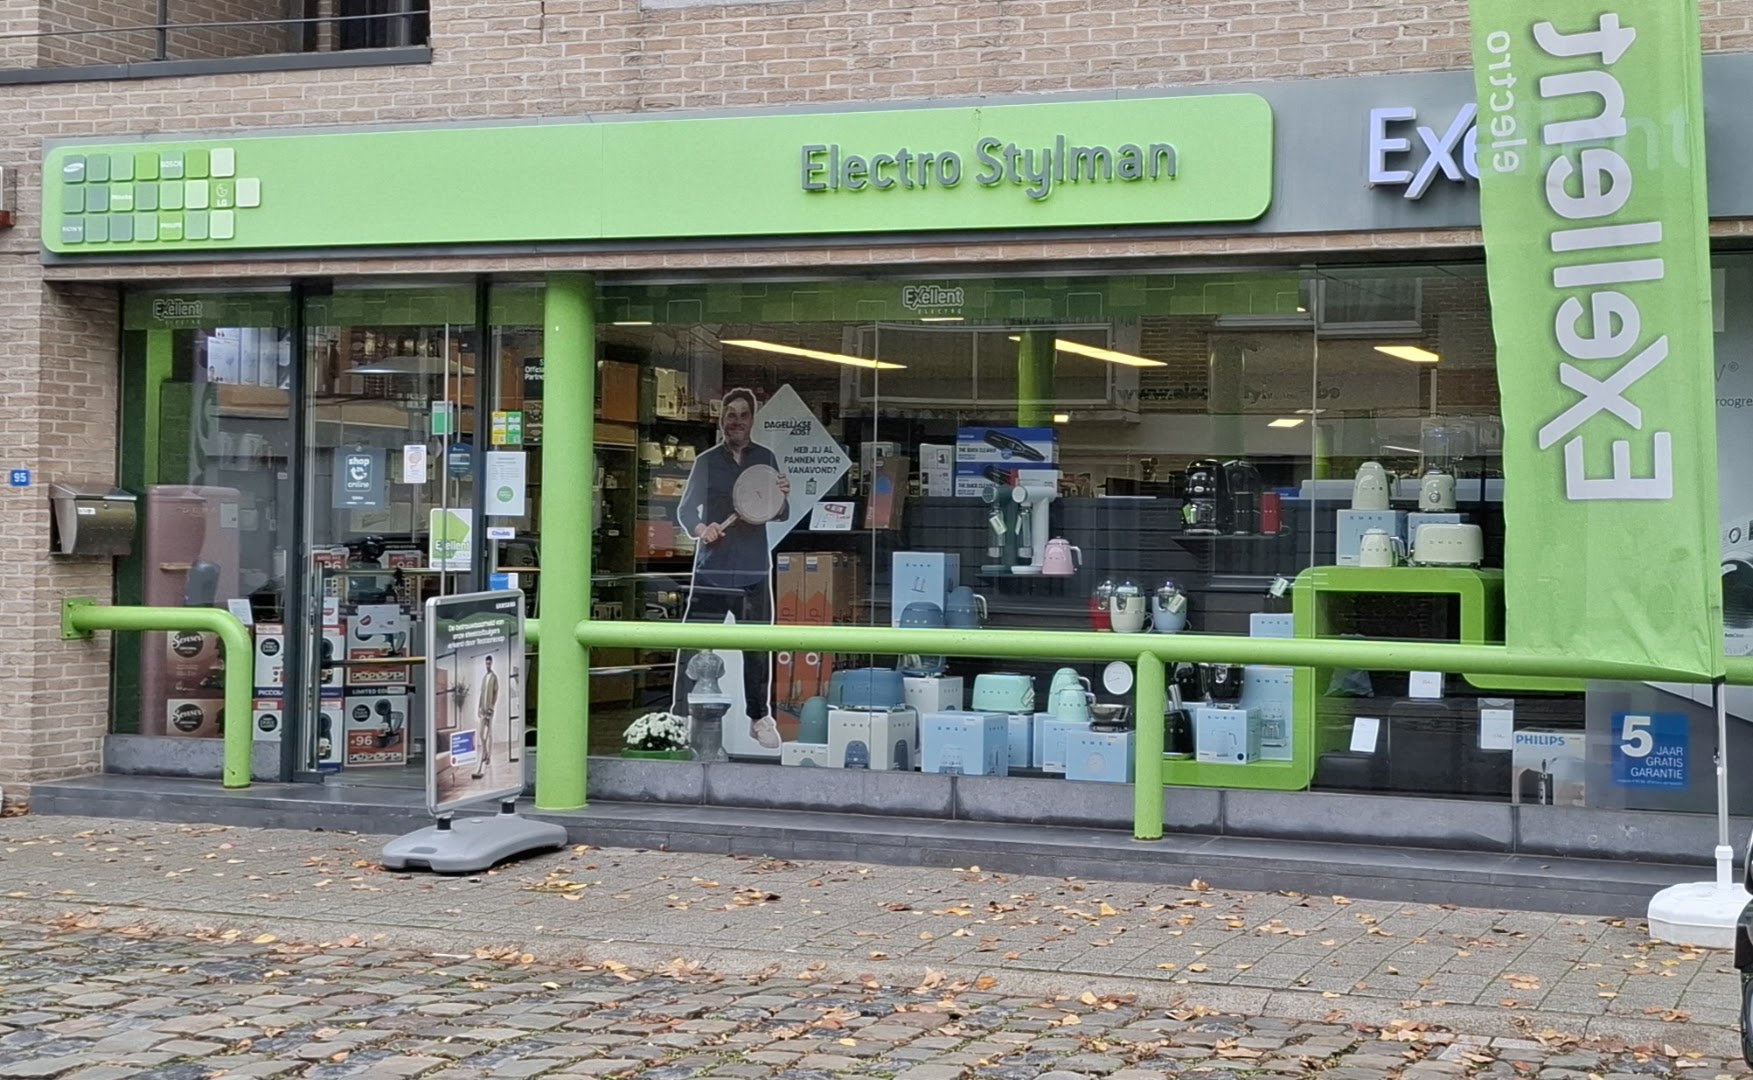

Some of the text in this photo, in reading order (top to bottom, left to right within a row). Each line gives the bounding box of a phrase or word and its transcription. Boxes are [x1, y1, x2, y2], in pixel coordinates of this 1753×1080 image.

[801, 134, 1178, 200] Electro Stylman
[217, 199, 227, 207] LG
[906, 288, 961, 307] Exellent
[348, 457, 370, 466] shop
[784, 456, 840, 464] PANNEN VOOR
[788, 466, 837, 474] VANAVOND?
[13, 472, 27, 483] 95
[435, 540, 471, 552] Eellent
[1516, 735, 1565, 746] PHILIPS
[1620, 715, 1653, 757] 5
[1656, 747, 1683, 756] JAAR
[1646, 757, 1683, 768] GRATIS
[1631, 767, 1683, 779] GARANTIE
